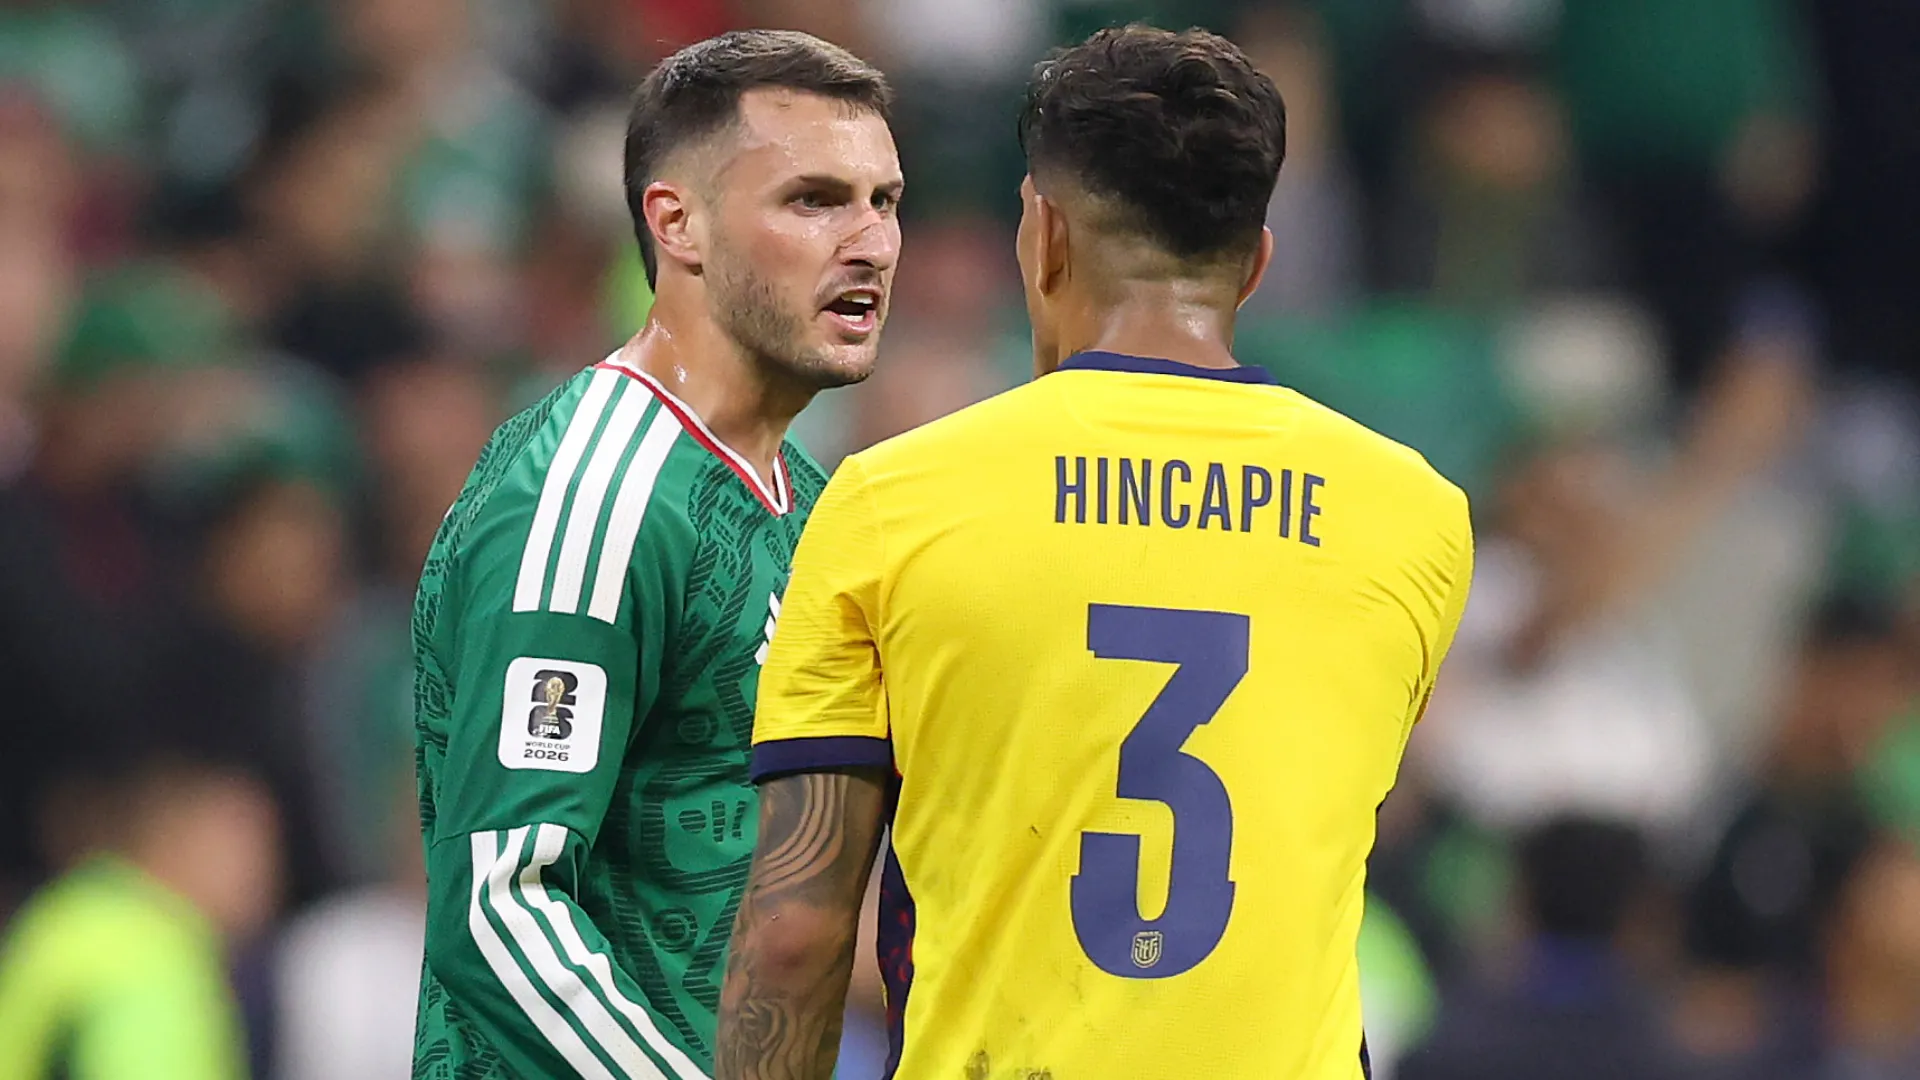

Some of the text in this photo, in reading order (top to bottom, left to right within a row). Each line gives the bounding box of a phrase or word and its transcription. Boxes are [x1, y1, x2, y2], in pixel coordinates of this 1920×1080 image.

[1055, 455, 1325, 547] HINCAPIE
[540, 723, 561, 735] FIFA
[525, 741, 553, 749] WORLD
[524, 748, 569, 761] 2026
[1070, 603, 1250, 979] 3
